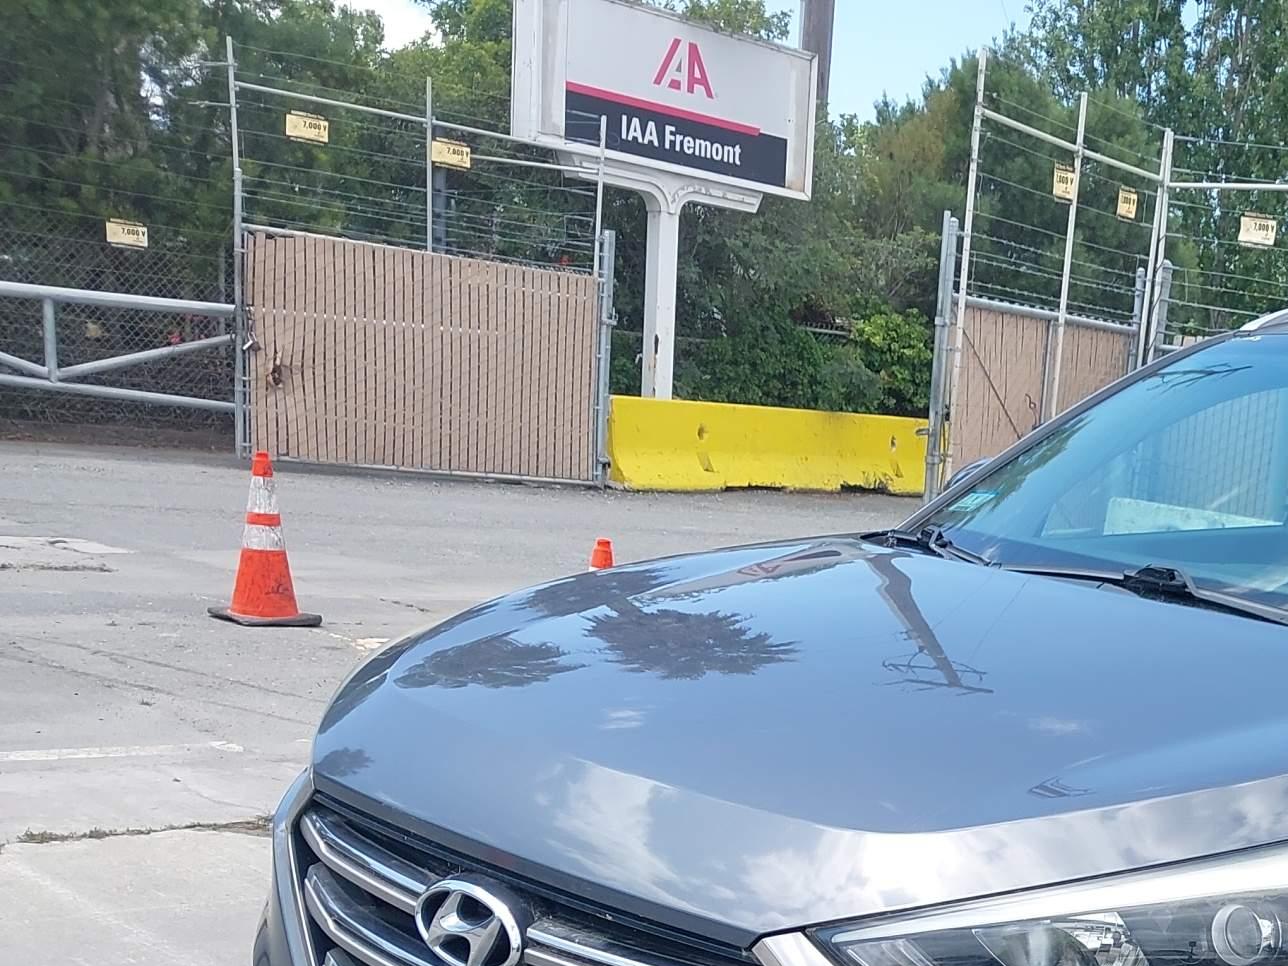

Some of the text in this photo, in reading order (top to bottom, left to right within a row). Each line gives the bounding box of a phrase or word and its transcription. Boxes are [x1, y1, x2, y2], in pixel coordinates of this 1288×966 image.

[302, 120, 321, 131] 7,000
[621, 114, 741, 166] IAA Fremont
[121, 227, 140, 237] 7,000
